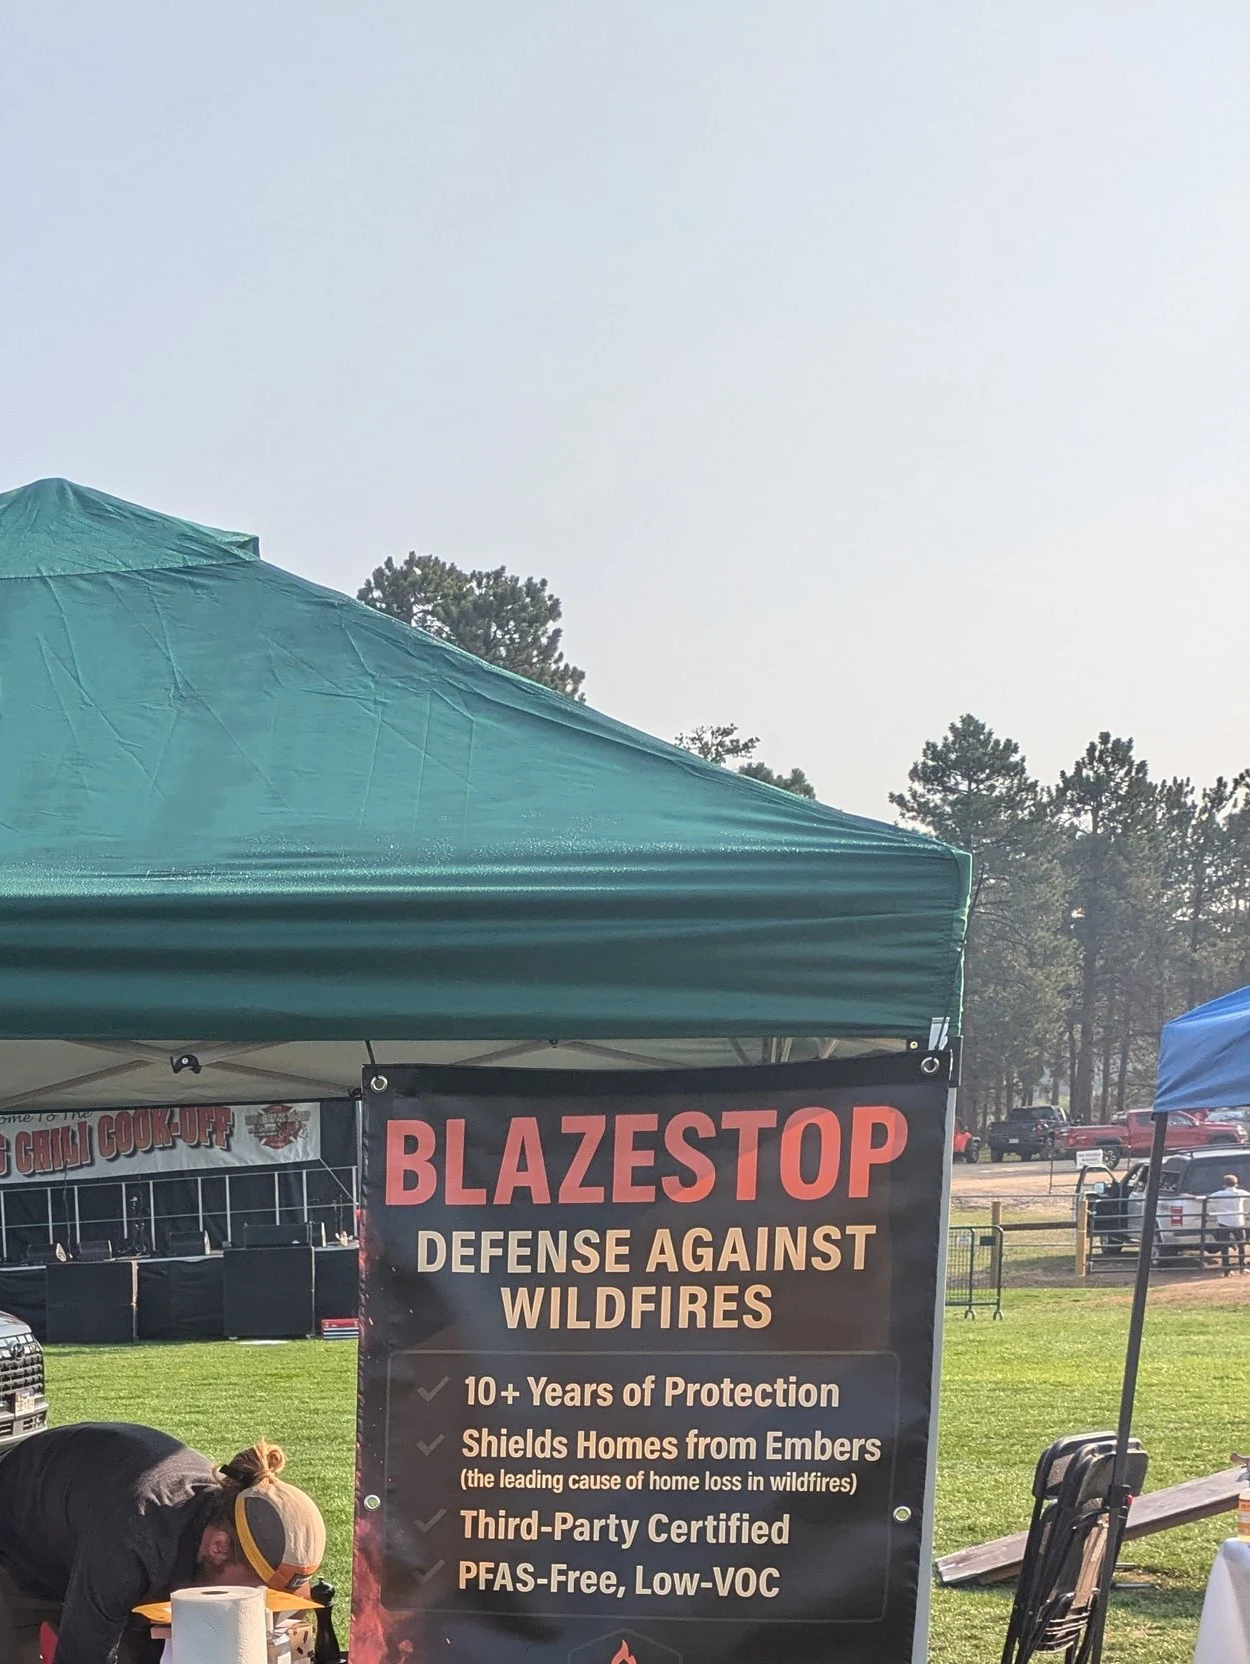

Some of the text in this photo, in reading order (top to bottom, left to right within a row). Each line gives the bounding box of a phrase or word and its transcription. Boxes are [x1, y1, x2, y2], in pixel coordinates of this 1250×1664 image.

[15, 1121, 92, 1175] CHILI
[98, 1107, 233, 1159] COOK-OFF
[385, 1106, 909, 1206] BLAZESTOP
[417, 1225, 877, 1274] DEFENSE AGAINST
[501, 1284, 773, 1330] WILDFIRES
[464, 1375, 840, 1408] 10+ Years of Protection
[461, 1428, 882, 1463] Shields Homes from Embers
[460, 1469, 858, 1496] (the leading cause of home loss in wildfires)
[460, 1509, 790, 1549] Third-Party Certified
[458, 1561, 780, 1599] PFAS-Free, Low-VOC
